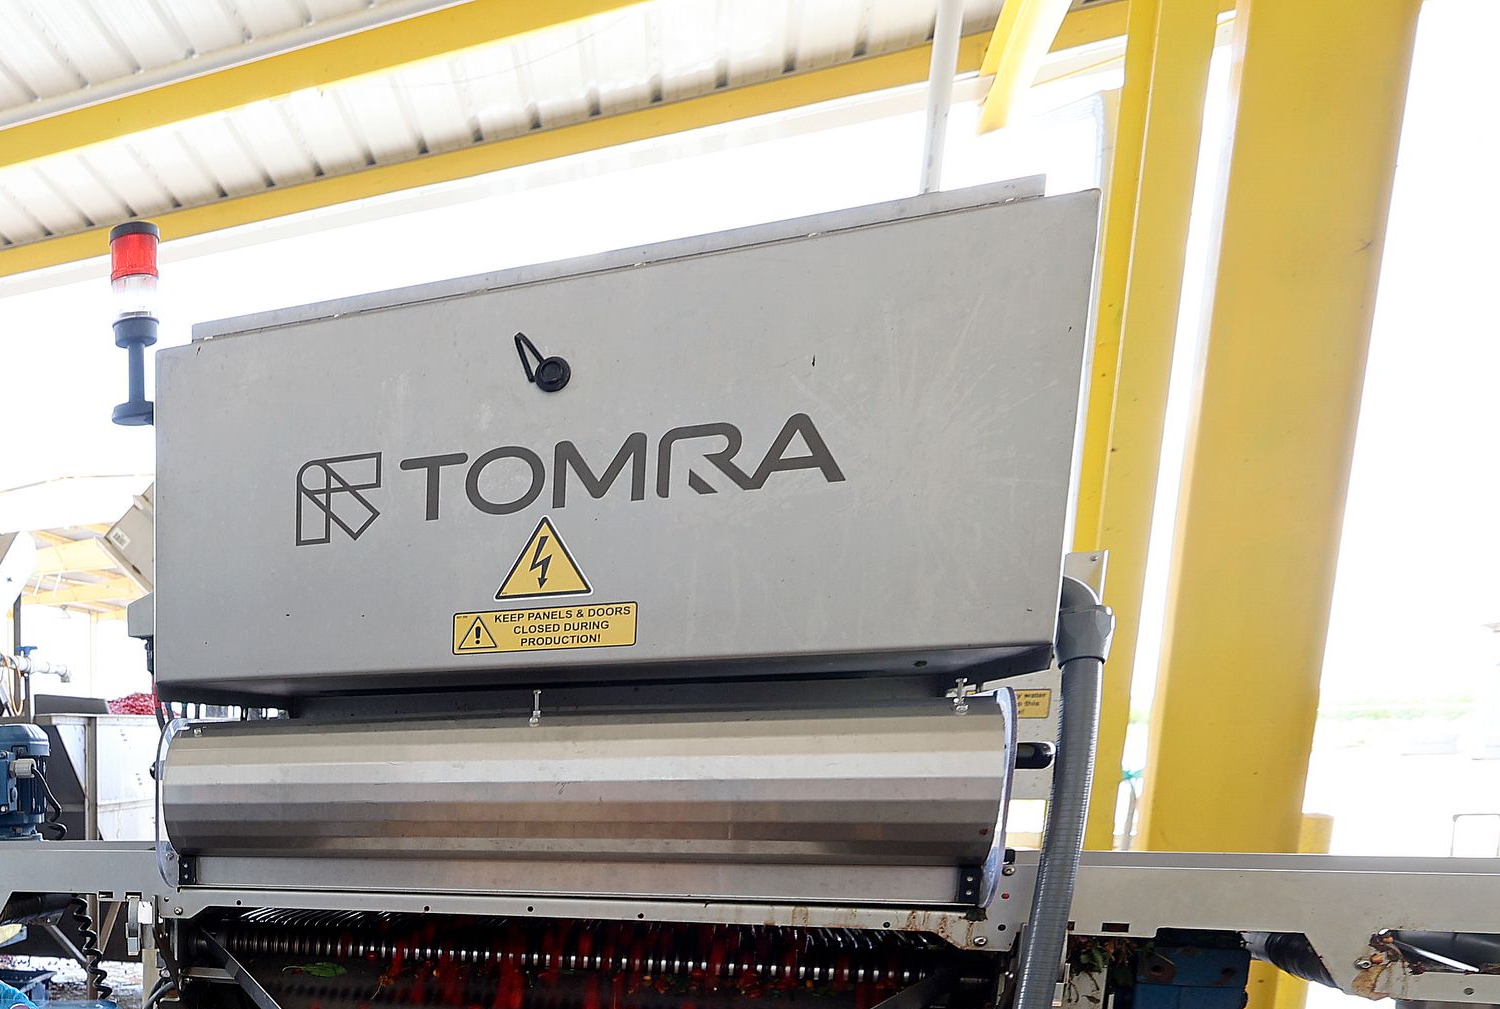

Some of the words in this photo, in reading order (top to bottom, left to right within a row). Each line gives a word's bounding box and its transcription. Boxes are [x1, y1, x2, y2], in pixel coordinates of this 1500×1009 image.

[400, 412, 846, 520] TOMRA
[494, 613, 524, 623] KEEP
[527, 610, 573, 621] PANELS
[576, 609, 585, 618] &
[587, 606, 631, 617] DOORS
[513, 623, 560, 634] CLOSED
[563, 620, 609, 632] DURING
[520, 634, 601, 647] PRODUCTION!
